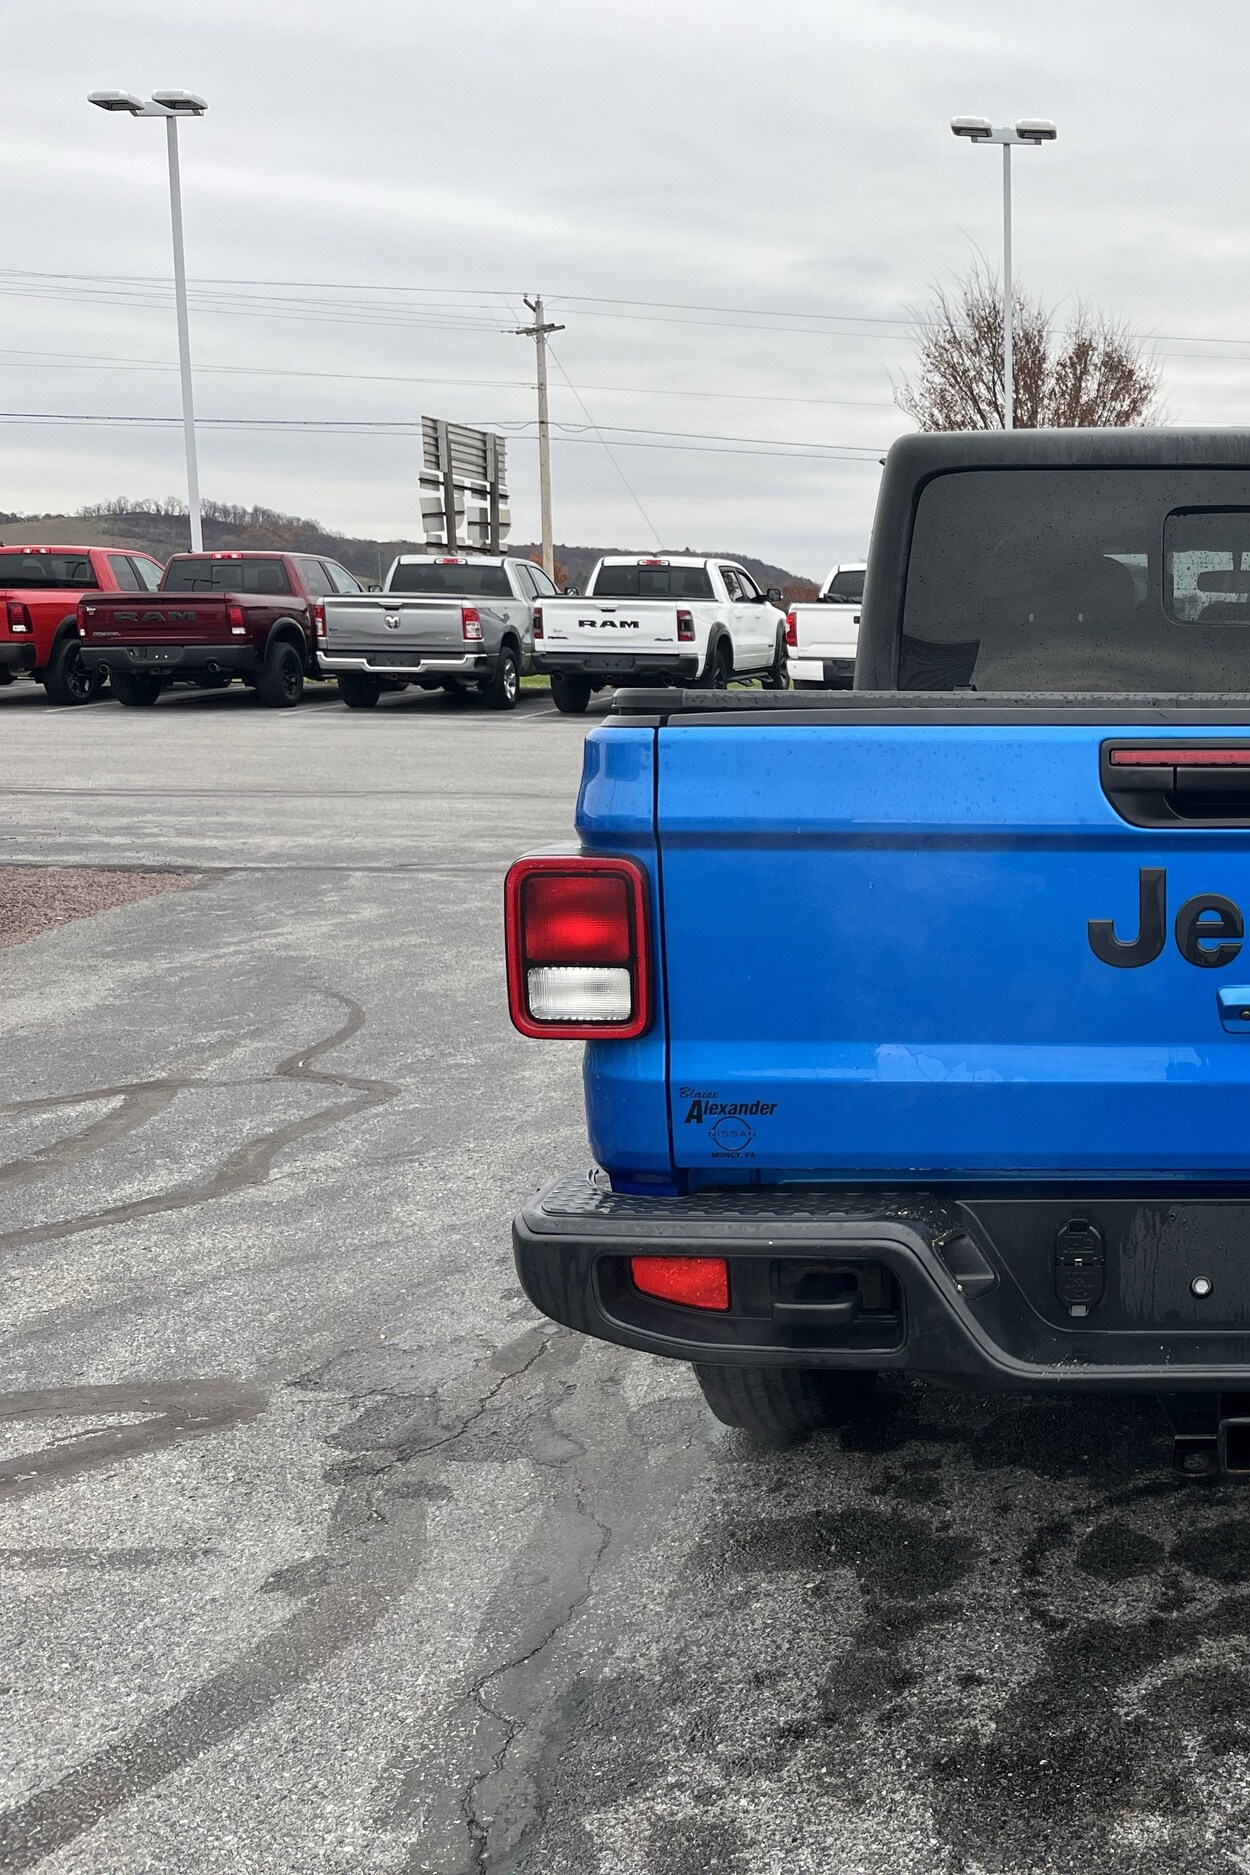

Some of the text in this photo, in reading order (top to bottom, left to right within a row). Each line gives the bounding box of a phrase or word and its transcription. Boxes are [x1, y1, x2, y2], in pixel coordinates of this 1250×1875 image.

[113, 611, 197, 623] RAM
[578, 620, 640, 628] RAM
[678, 1086, 720, 1099] Blaise
[684, 1099, 778, 1124] Alexander
[708, 1130, 757, 1138] NISSAN
